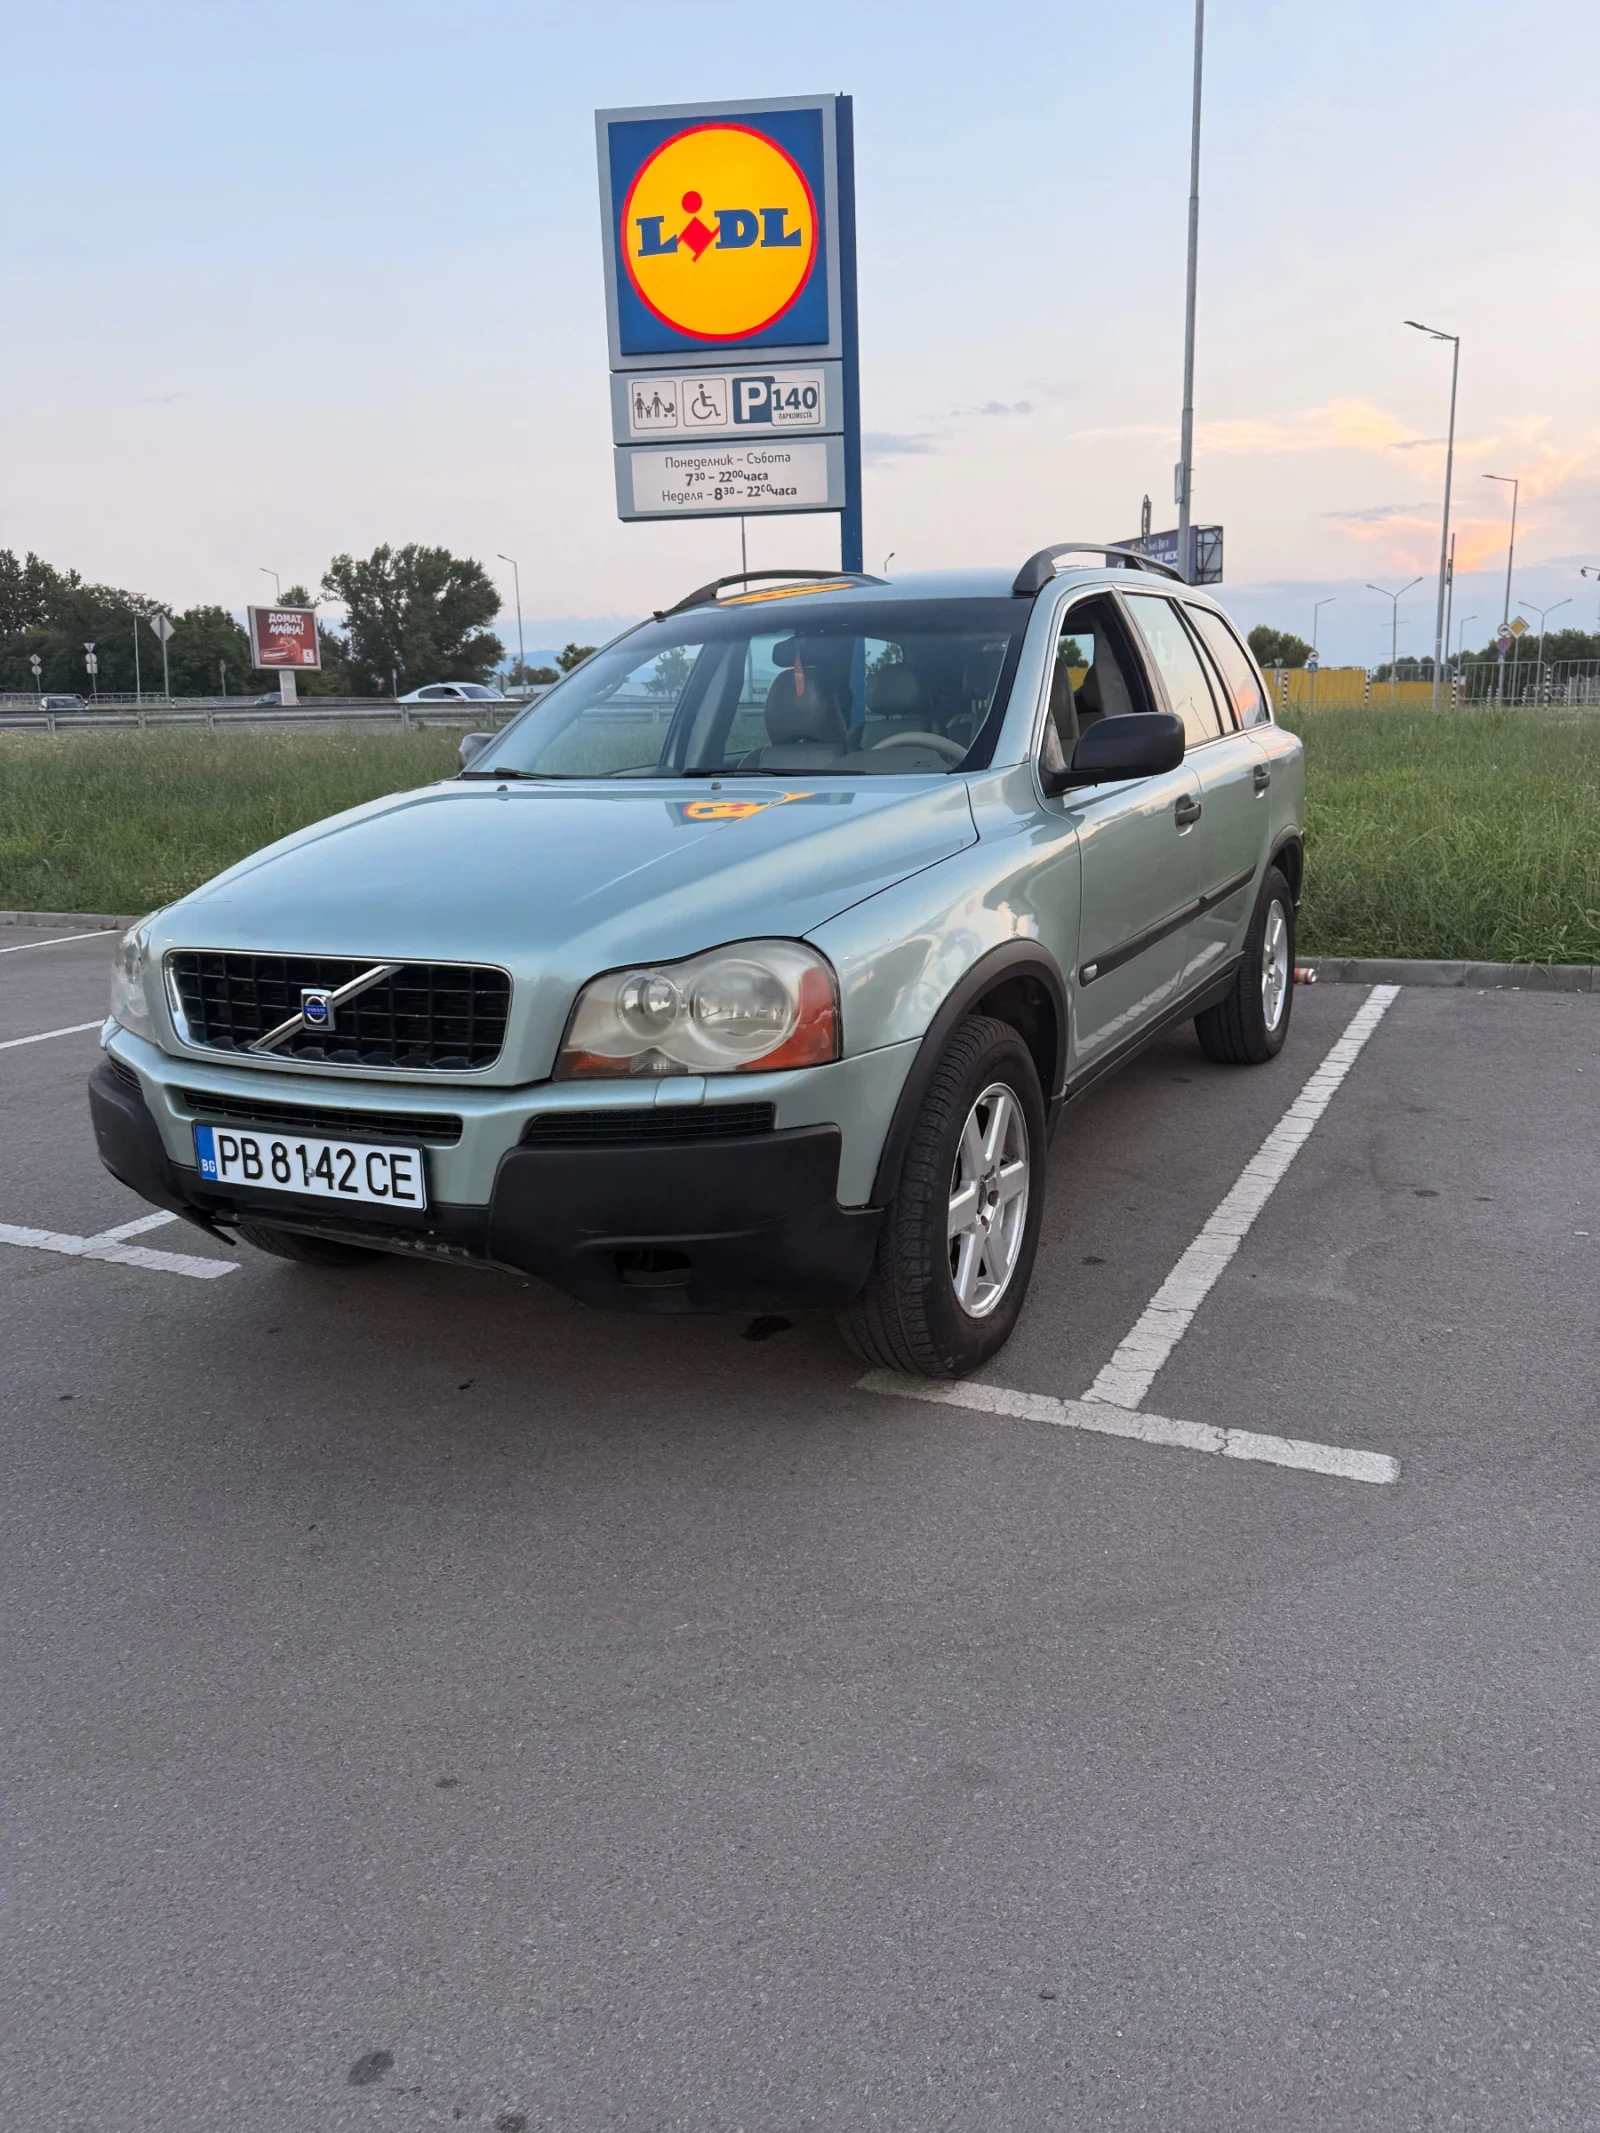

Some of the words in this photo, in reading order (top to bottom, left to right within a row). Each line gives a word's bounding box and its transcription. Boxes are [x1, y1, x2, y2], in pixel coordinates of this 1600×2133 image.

[772, 387, 818, 411] 140
[778, 411, 813, 420] ПАРКОМЕСТА
[665, 454, 734, 470] Понеделник
[746, 452, 791, 465] Събота
[662, 490, 704, 505] Неделя
[201, 1158, 216, 1173] BG
